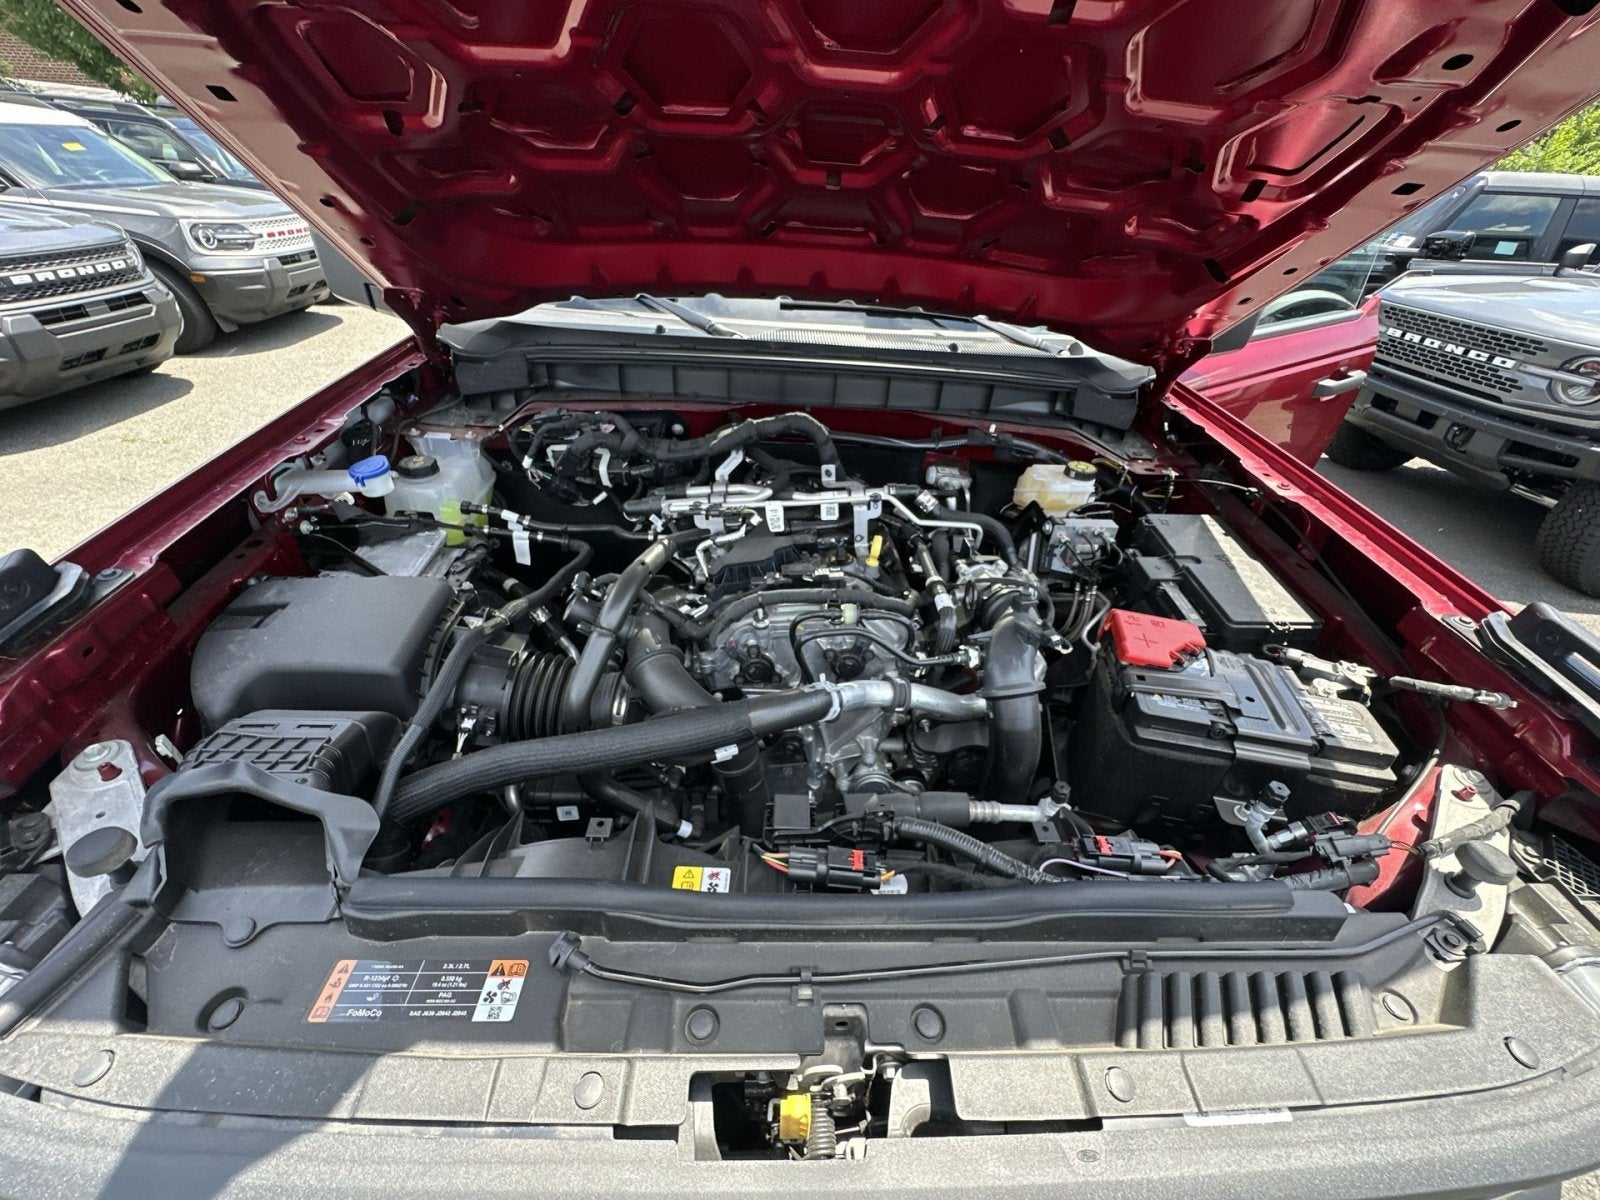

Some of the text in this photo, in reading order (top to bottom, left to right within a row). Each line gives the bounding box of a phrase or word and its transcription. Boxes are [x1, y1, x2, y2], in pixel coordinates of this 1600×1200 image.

[9, 260, 127, 285] BRONCO
[1386, 327, 1516, 369] BRONCO
[346, 1008, 382, 1017] FoMoCo
